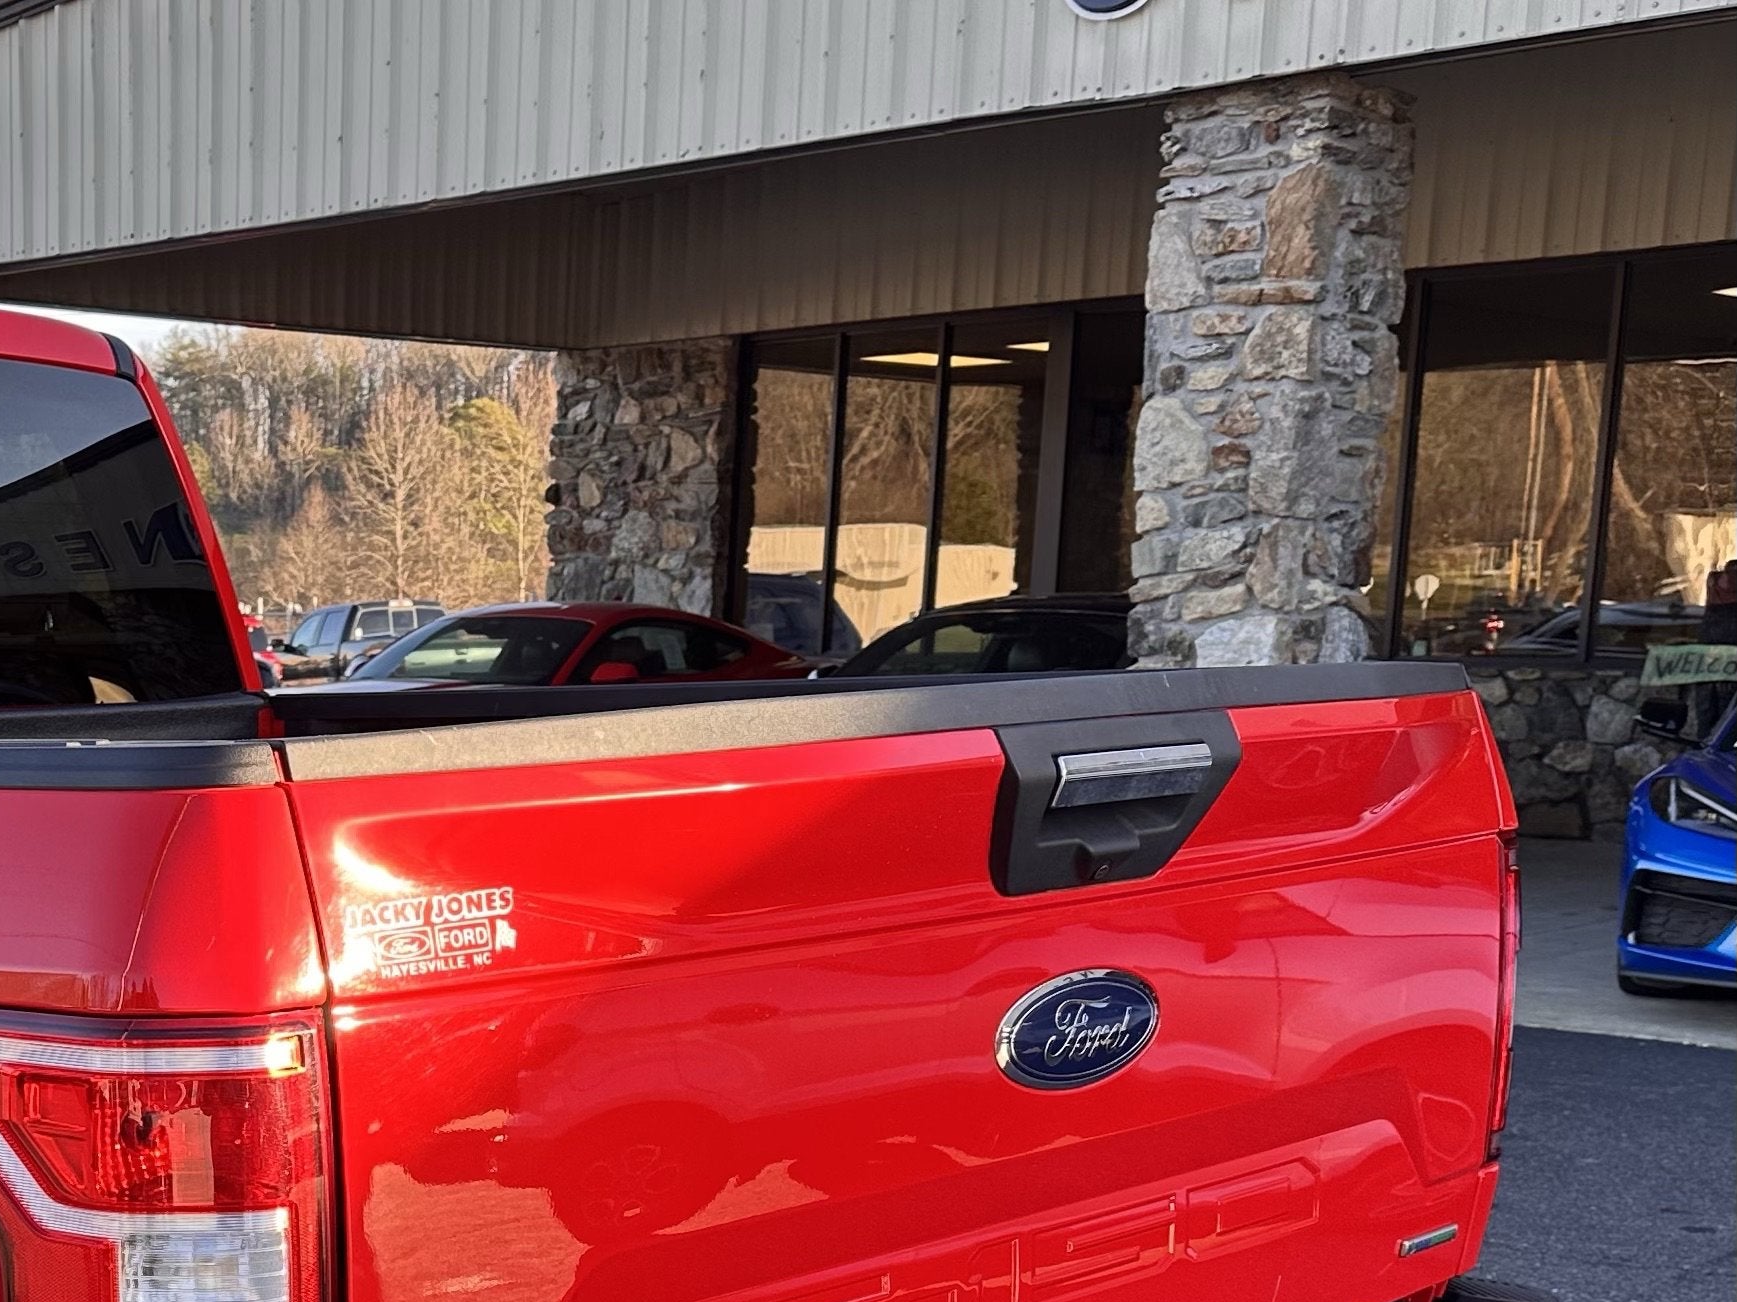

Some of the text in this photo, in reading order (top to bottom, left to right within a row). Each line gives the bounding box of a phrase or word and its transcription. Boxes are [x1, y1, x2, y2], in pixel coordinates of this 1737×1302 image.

[347, 888, 513, 929] JACKY JONES
[439, 926, 489, 950] FORD
[473, 952, 493, 966] NC
[1044, 995, 1133, 1067] Ford
